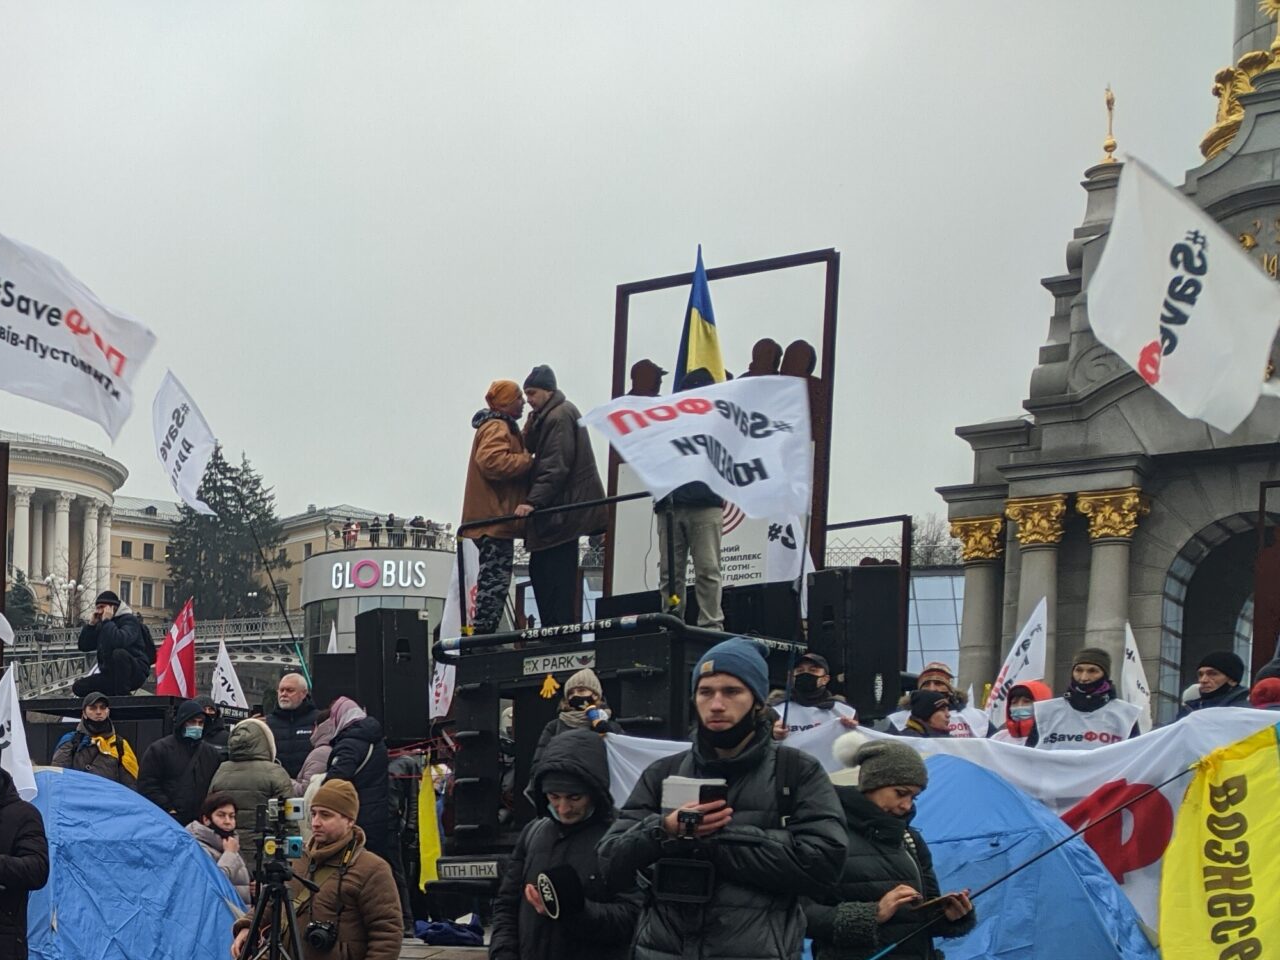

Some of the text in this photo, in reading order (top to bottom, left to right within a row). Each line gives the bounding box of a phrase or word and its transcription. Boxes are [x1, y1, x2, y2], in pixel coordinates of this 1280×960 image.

[331, 559, 426, 589] GLOBUS
[521, 619, 612, 639] +38 067 236 41 16
[531, 656, 574, 672] X PARK
[443, 864, 494, 877] ПТН ПНХ
